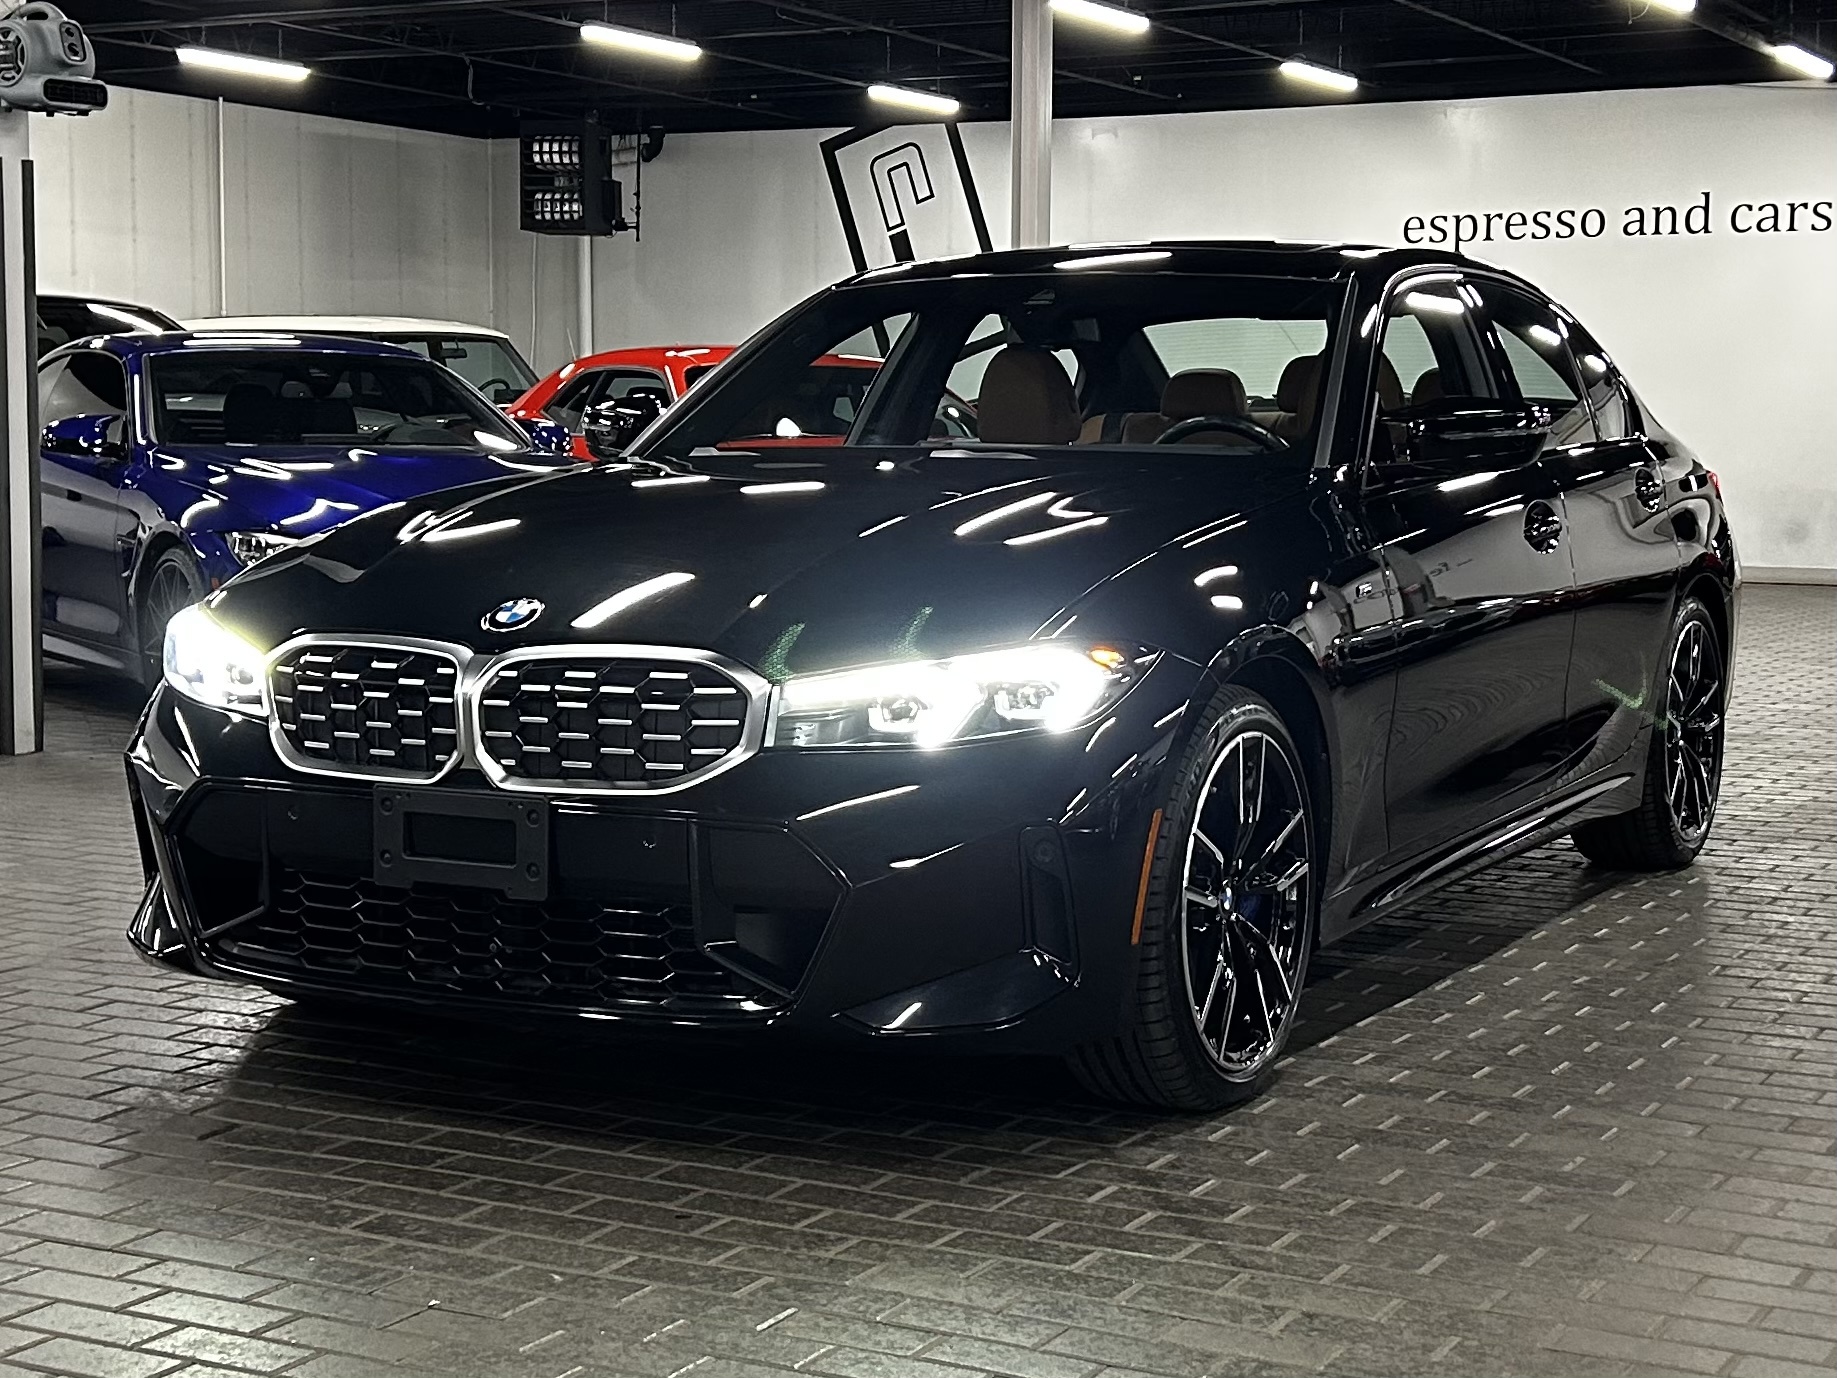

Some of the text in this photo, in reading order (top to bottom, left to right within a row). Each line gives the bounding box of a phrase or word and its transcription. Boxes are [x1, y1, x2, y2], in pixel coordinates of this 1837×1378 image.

[1403, 191, 1833, 253] espresso and cars
